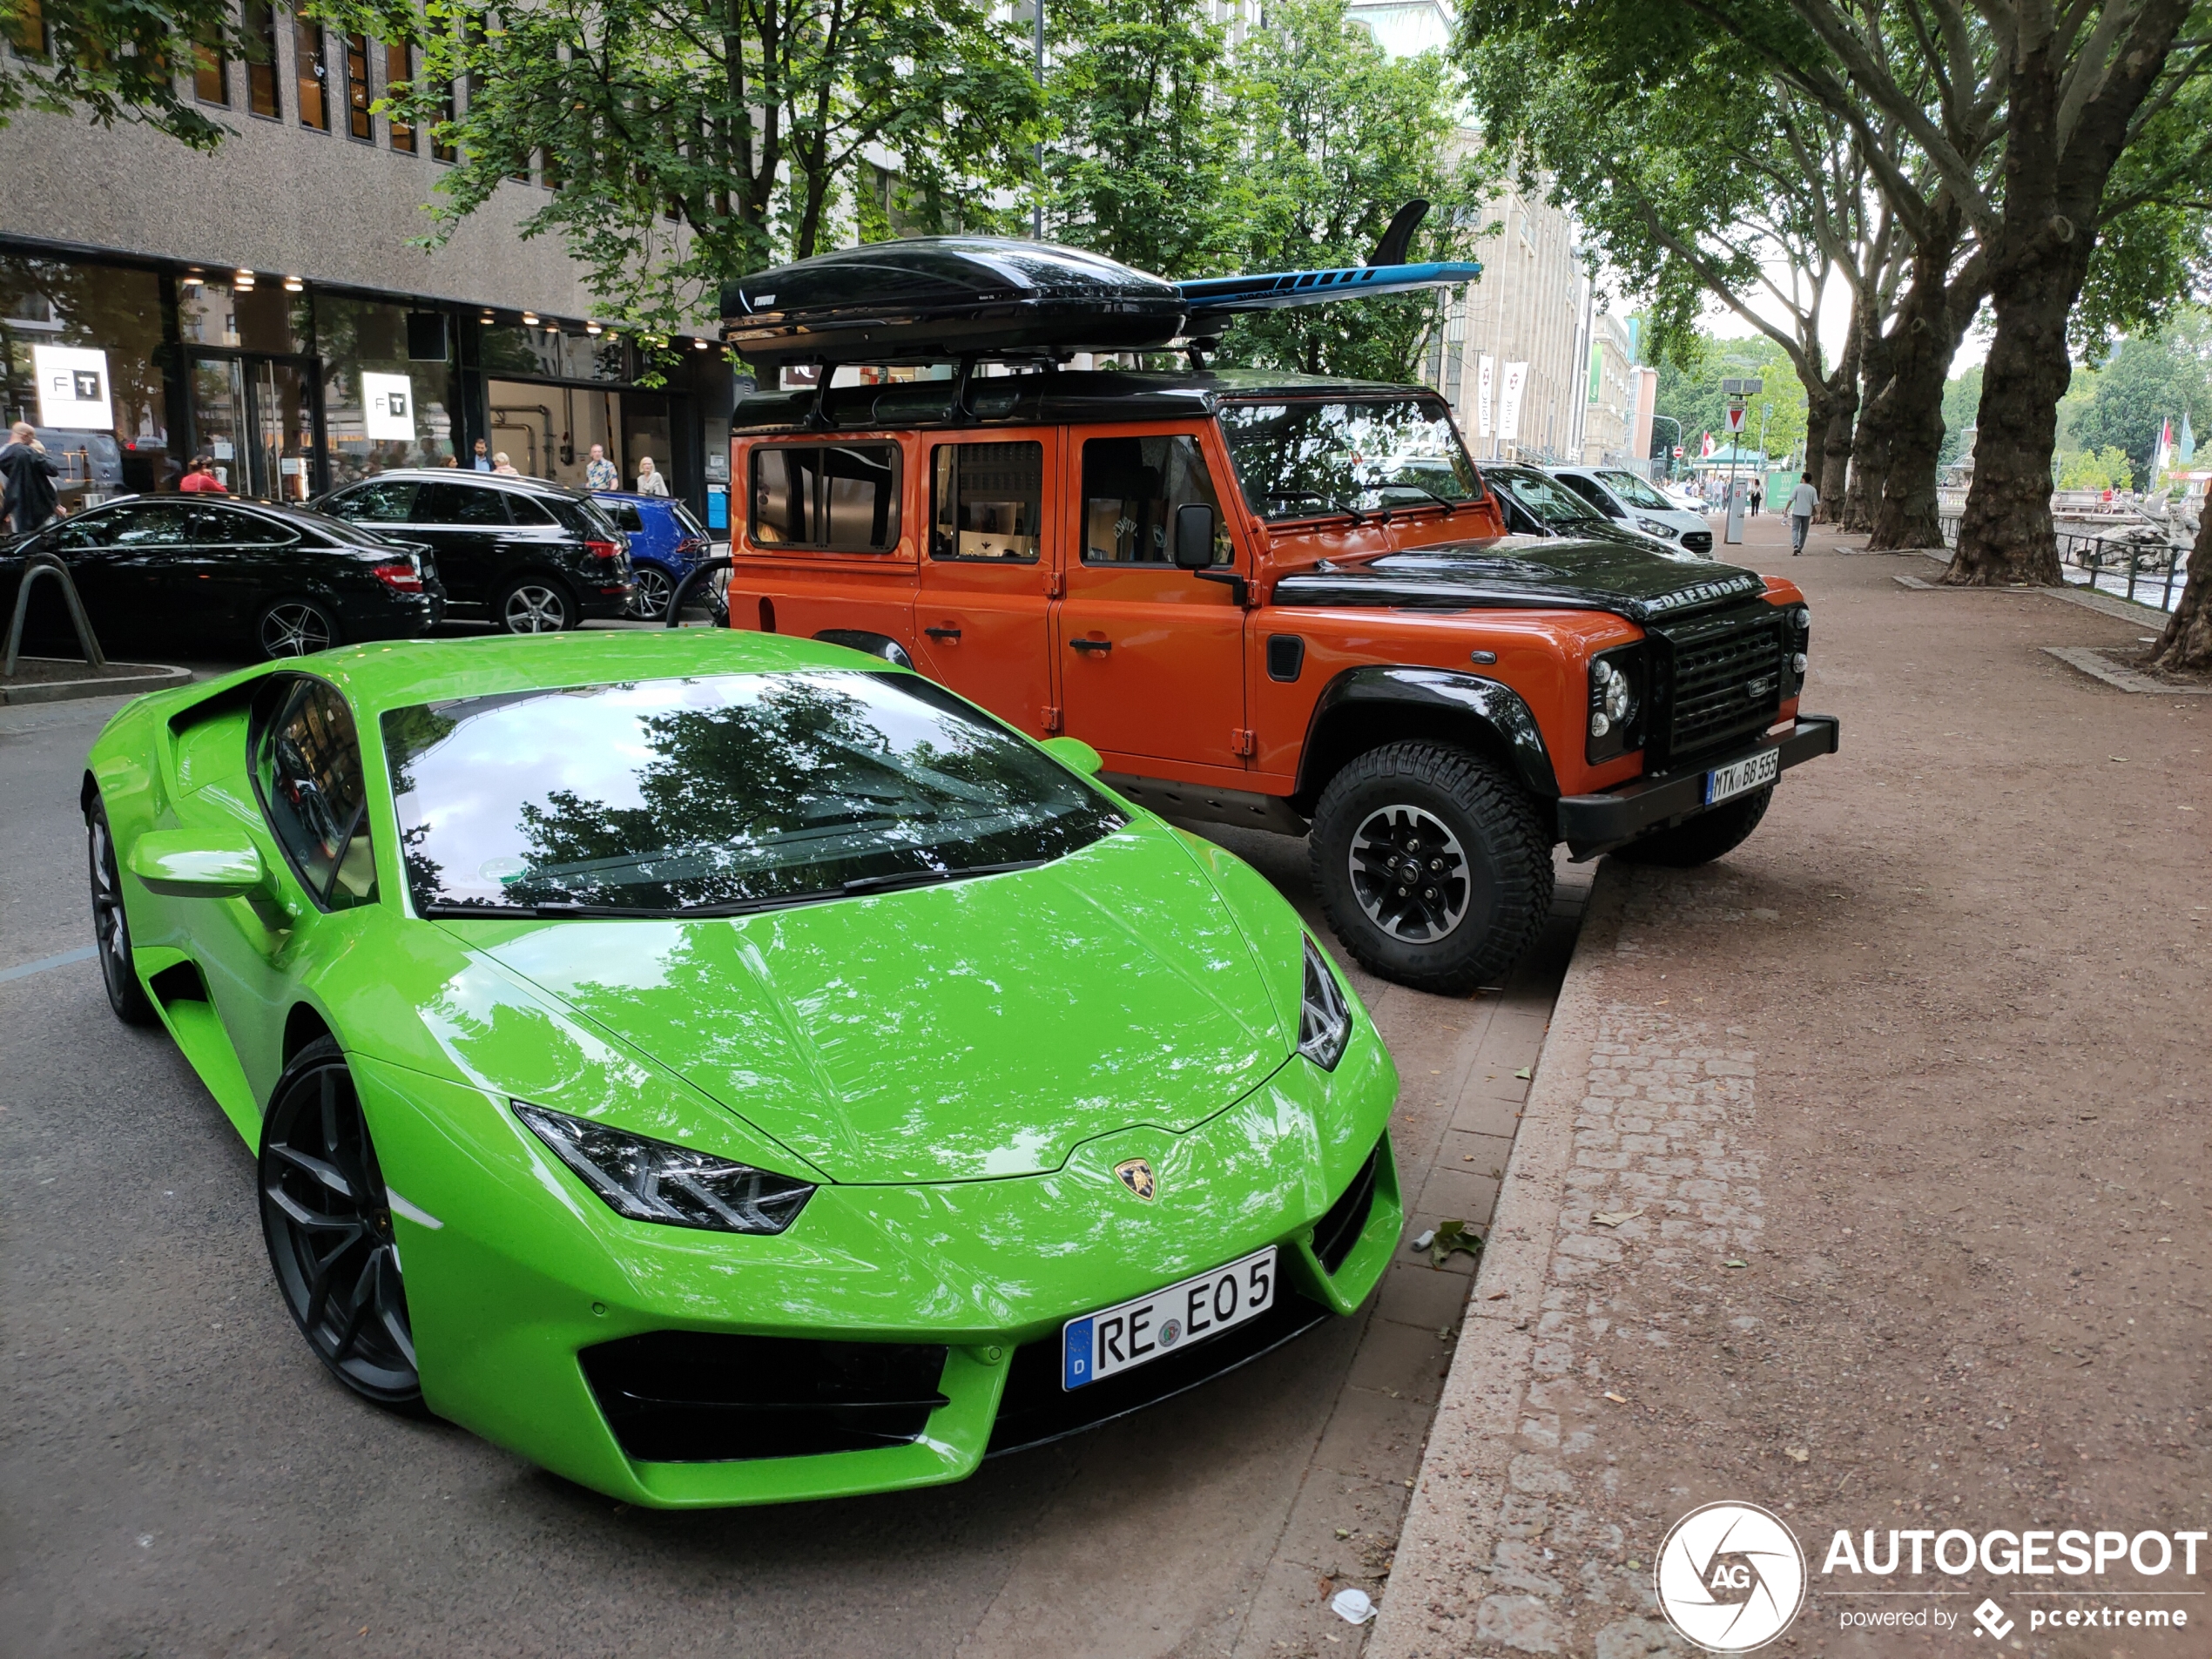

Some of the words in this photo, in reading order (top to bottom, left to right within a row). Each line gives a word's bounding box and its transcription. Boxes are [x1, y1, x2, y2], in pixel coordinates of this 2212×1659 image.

[1660, 577, 1753, 608] DEFENDER
[1714, 767, 1737, 798] MTK
[1743, 759, 1757, 786] BB
[1758, 752, 1777, 779] 555
[1099, 1305, 1155, 1370] RE
[1249, 1258, 1271, 1308] 5
[1074, 1359, 1085, 1375] D
